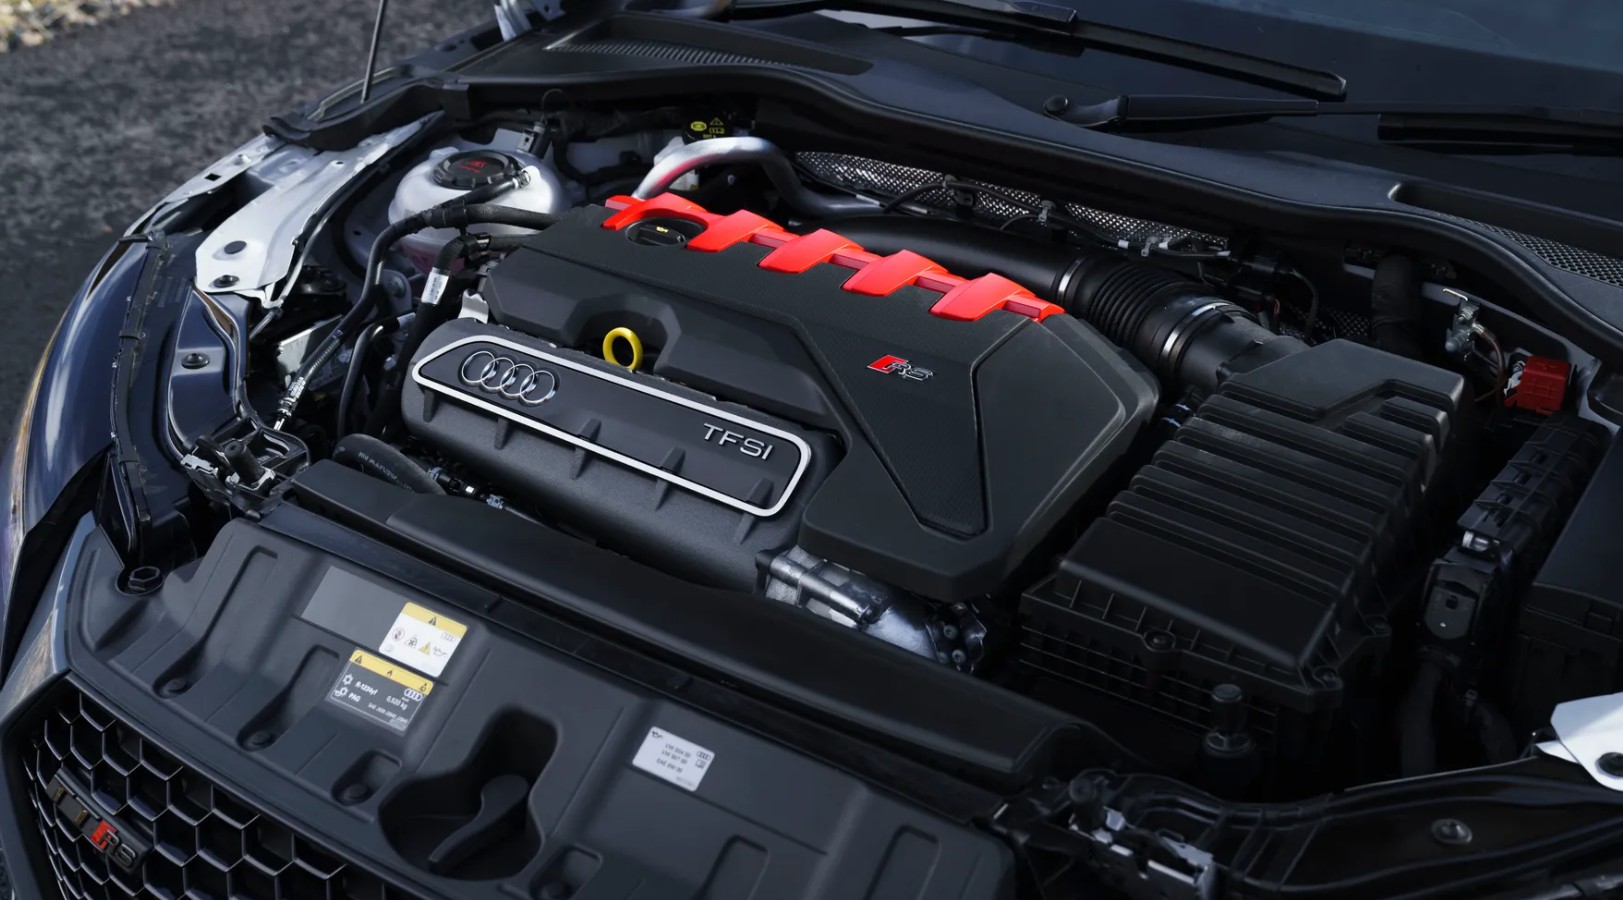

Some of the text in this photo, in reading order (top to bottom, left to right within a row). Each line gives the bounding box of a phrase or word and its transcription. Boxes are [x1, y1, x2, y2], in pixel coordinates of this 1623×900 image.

[872, 357, 933, 381] RS
[703, 422, 773, 460] TFSI
[348, 692, 361, 702] PAG
